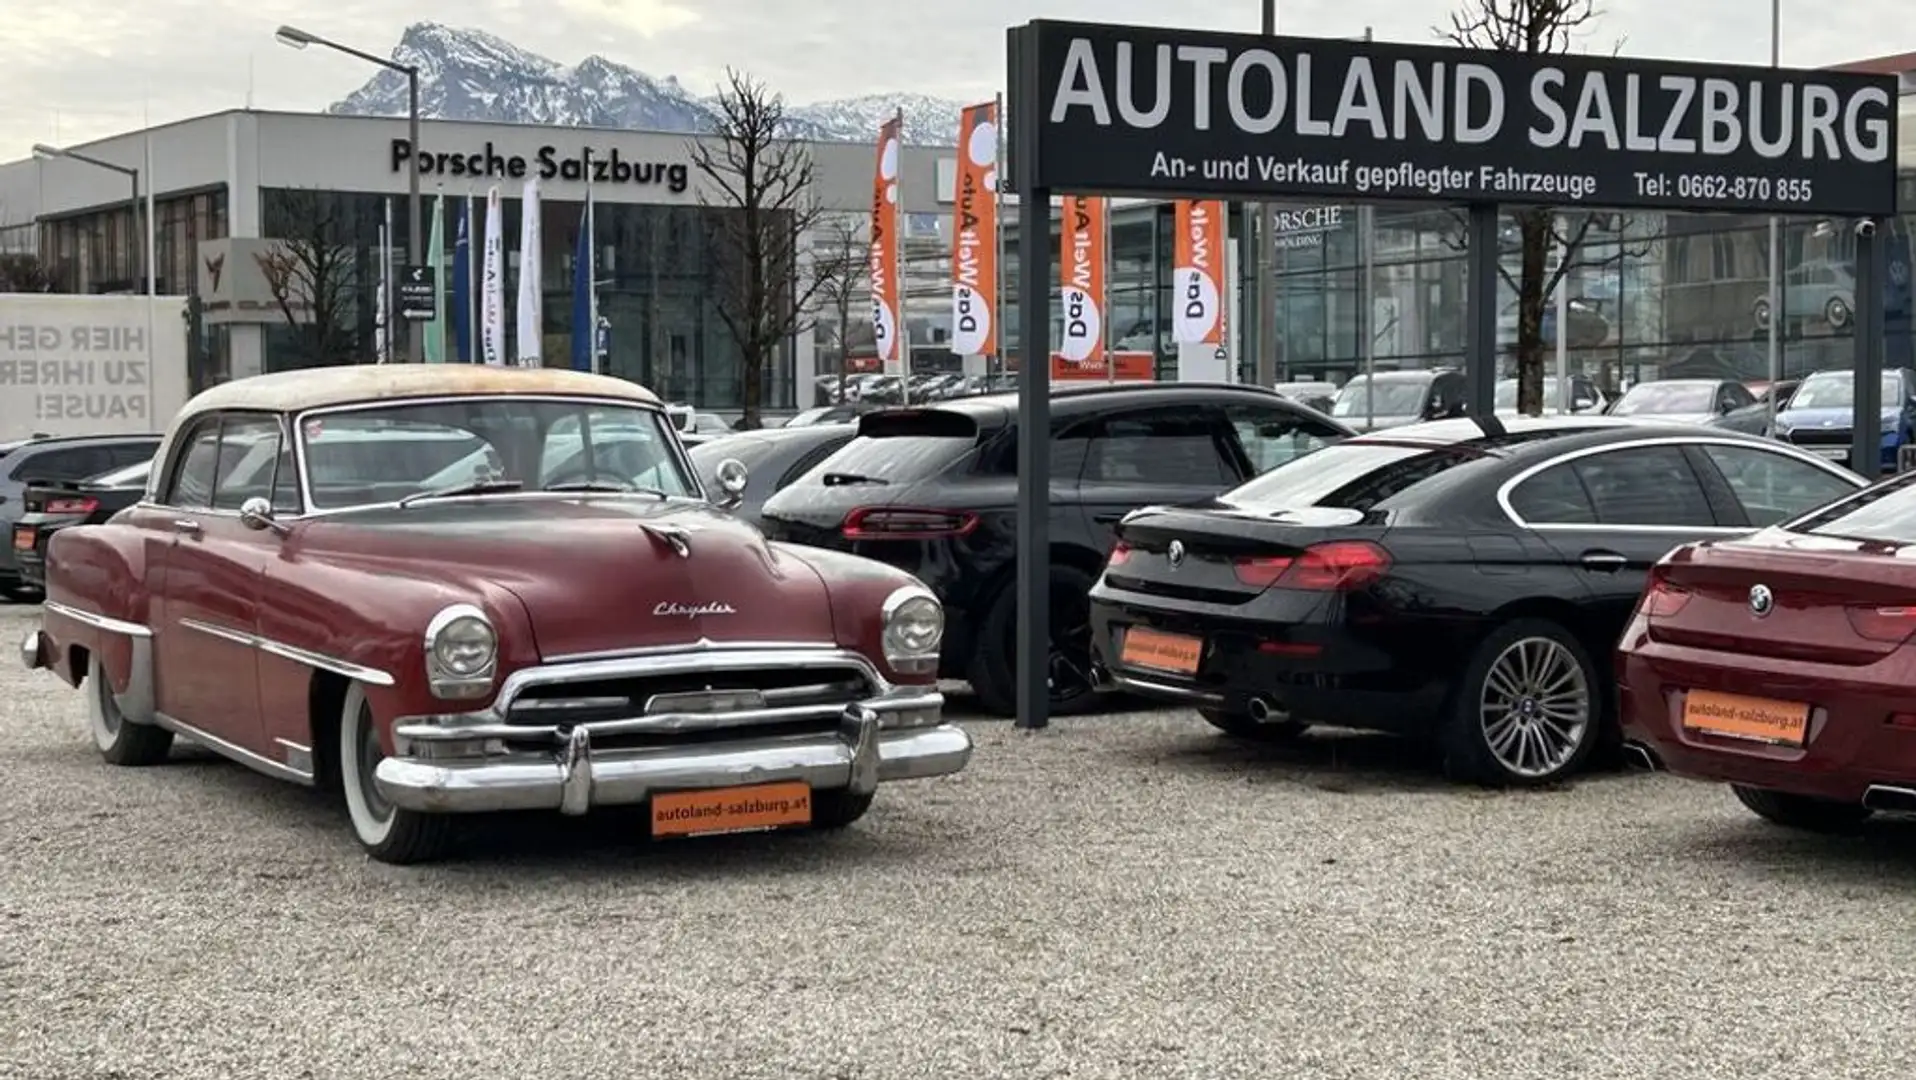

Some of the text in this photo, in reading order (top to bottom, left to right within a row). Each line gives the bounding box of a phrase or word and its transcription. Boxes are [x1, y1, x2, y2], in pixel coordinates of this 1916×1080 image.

[1050, 37, 1889, 163] AUTOLAND SALZBURG
[391, 138, 688, 194] Porsche Salzburg
[1150, 151, 1812, 202] An- und Verkauf gepflegter Fahrzeuge Tel: 0662-870 855
[652, 601, 737, 620] Chrysler
[655, 797, 808, 821] autoland-salzburg.at
